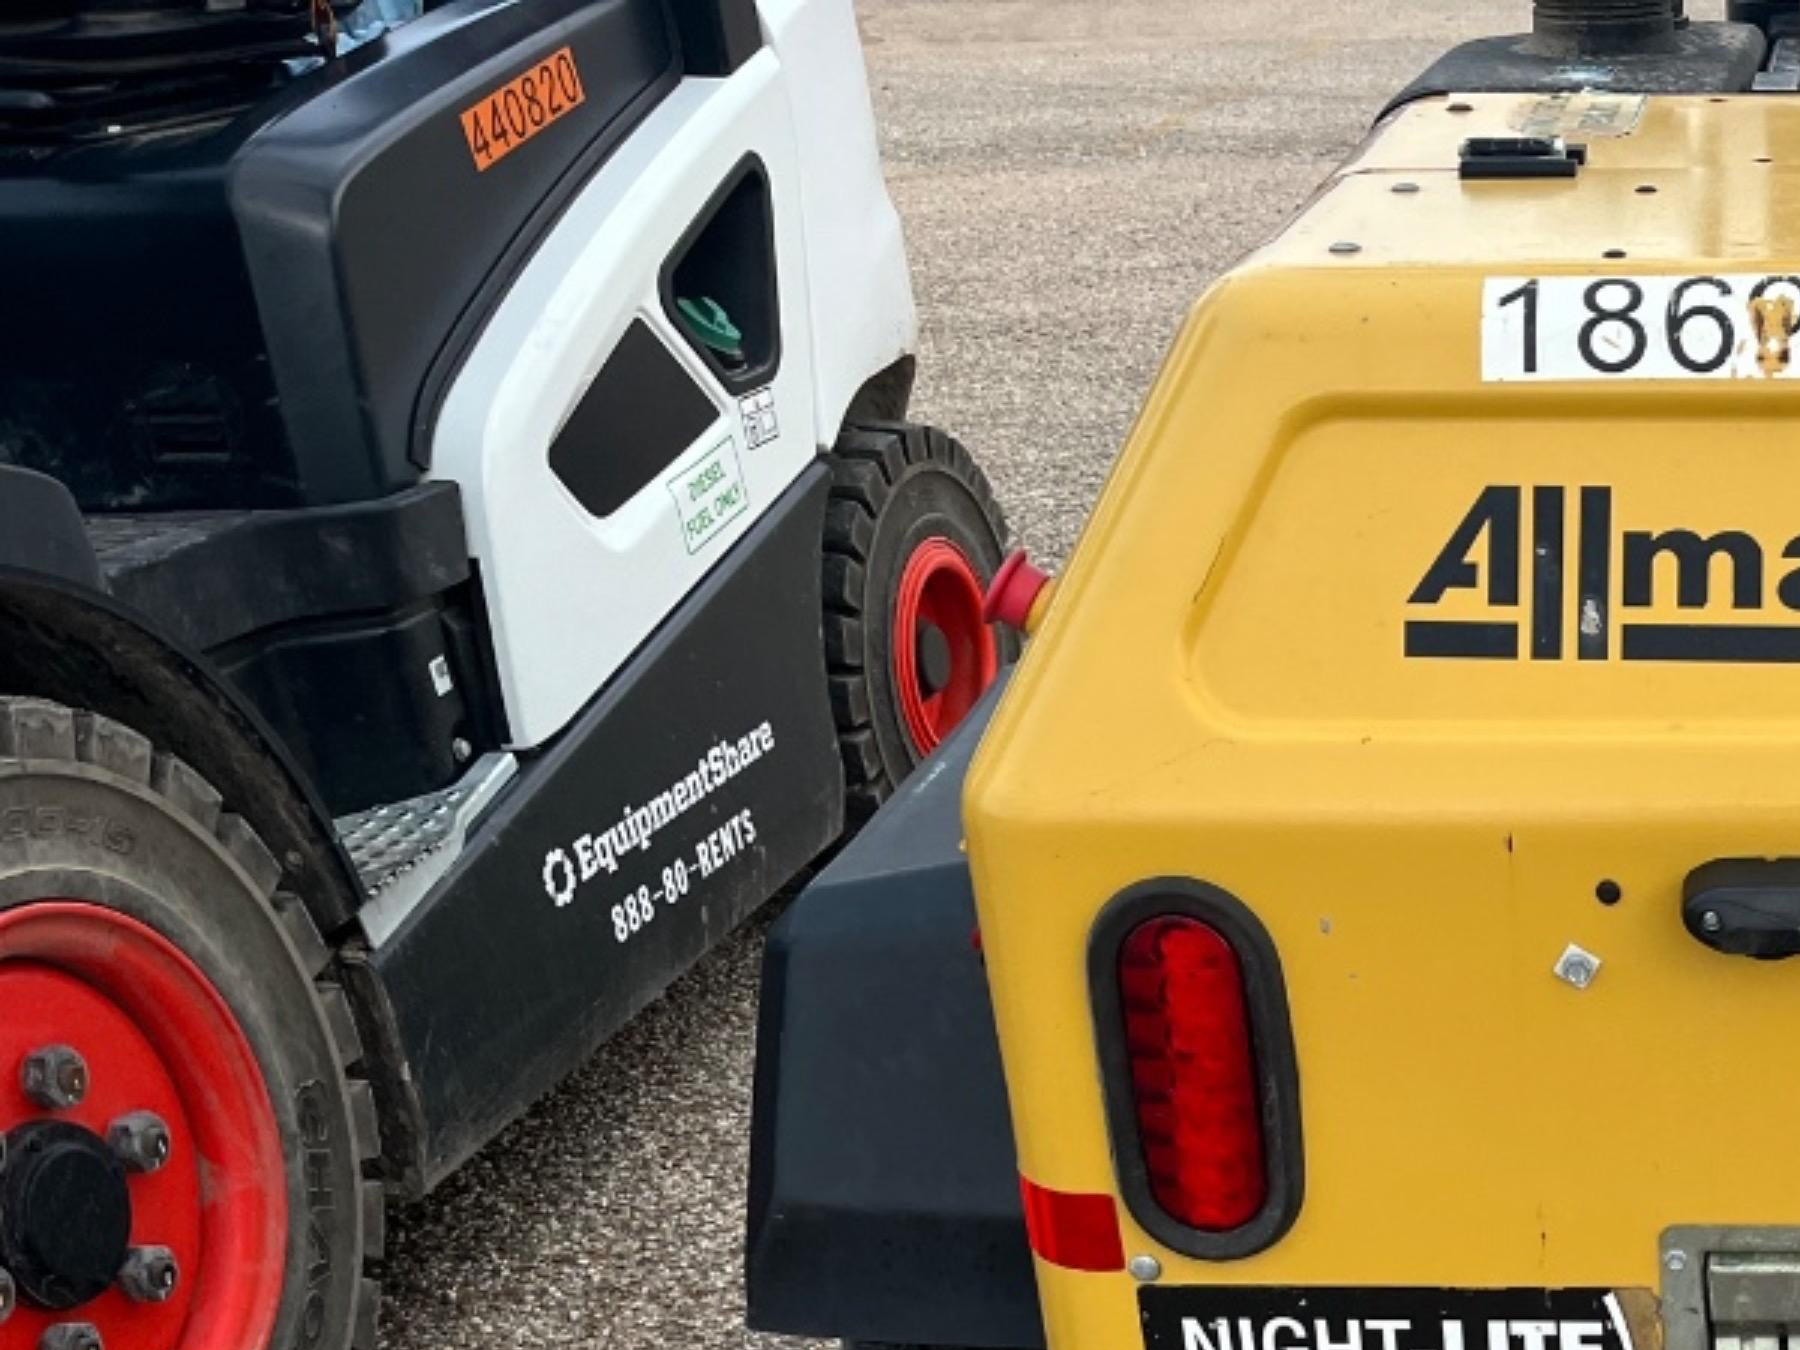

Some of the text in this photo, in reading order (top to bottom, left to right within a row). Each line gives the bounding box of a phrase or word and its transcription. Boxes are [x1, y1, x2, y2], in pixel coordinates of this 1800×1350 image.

[472, 52, 579, 160] 440820
[571, 718, 775, 883] EquipmentShare
[610, 806, 758, 943] 888-80-RENTS
